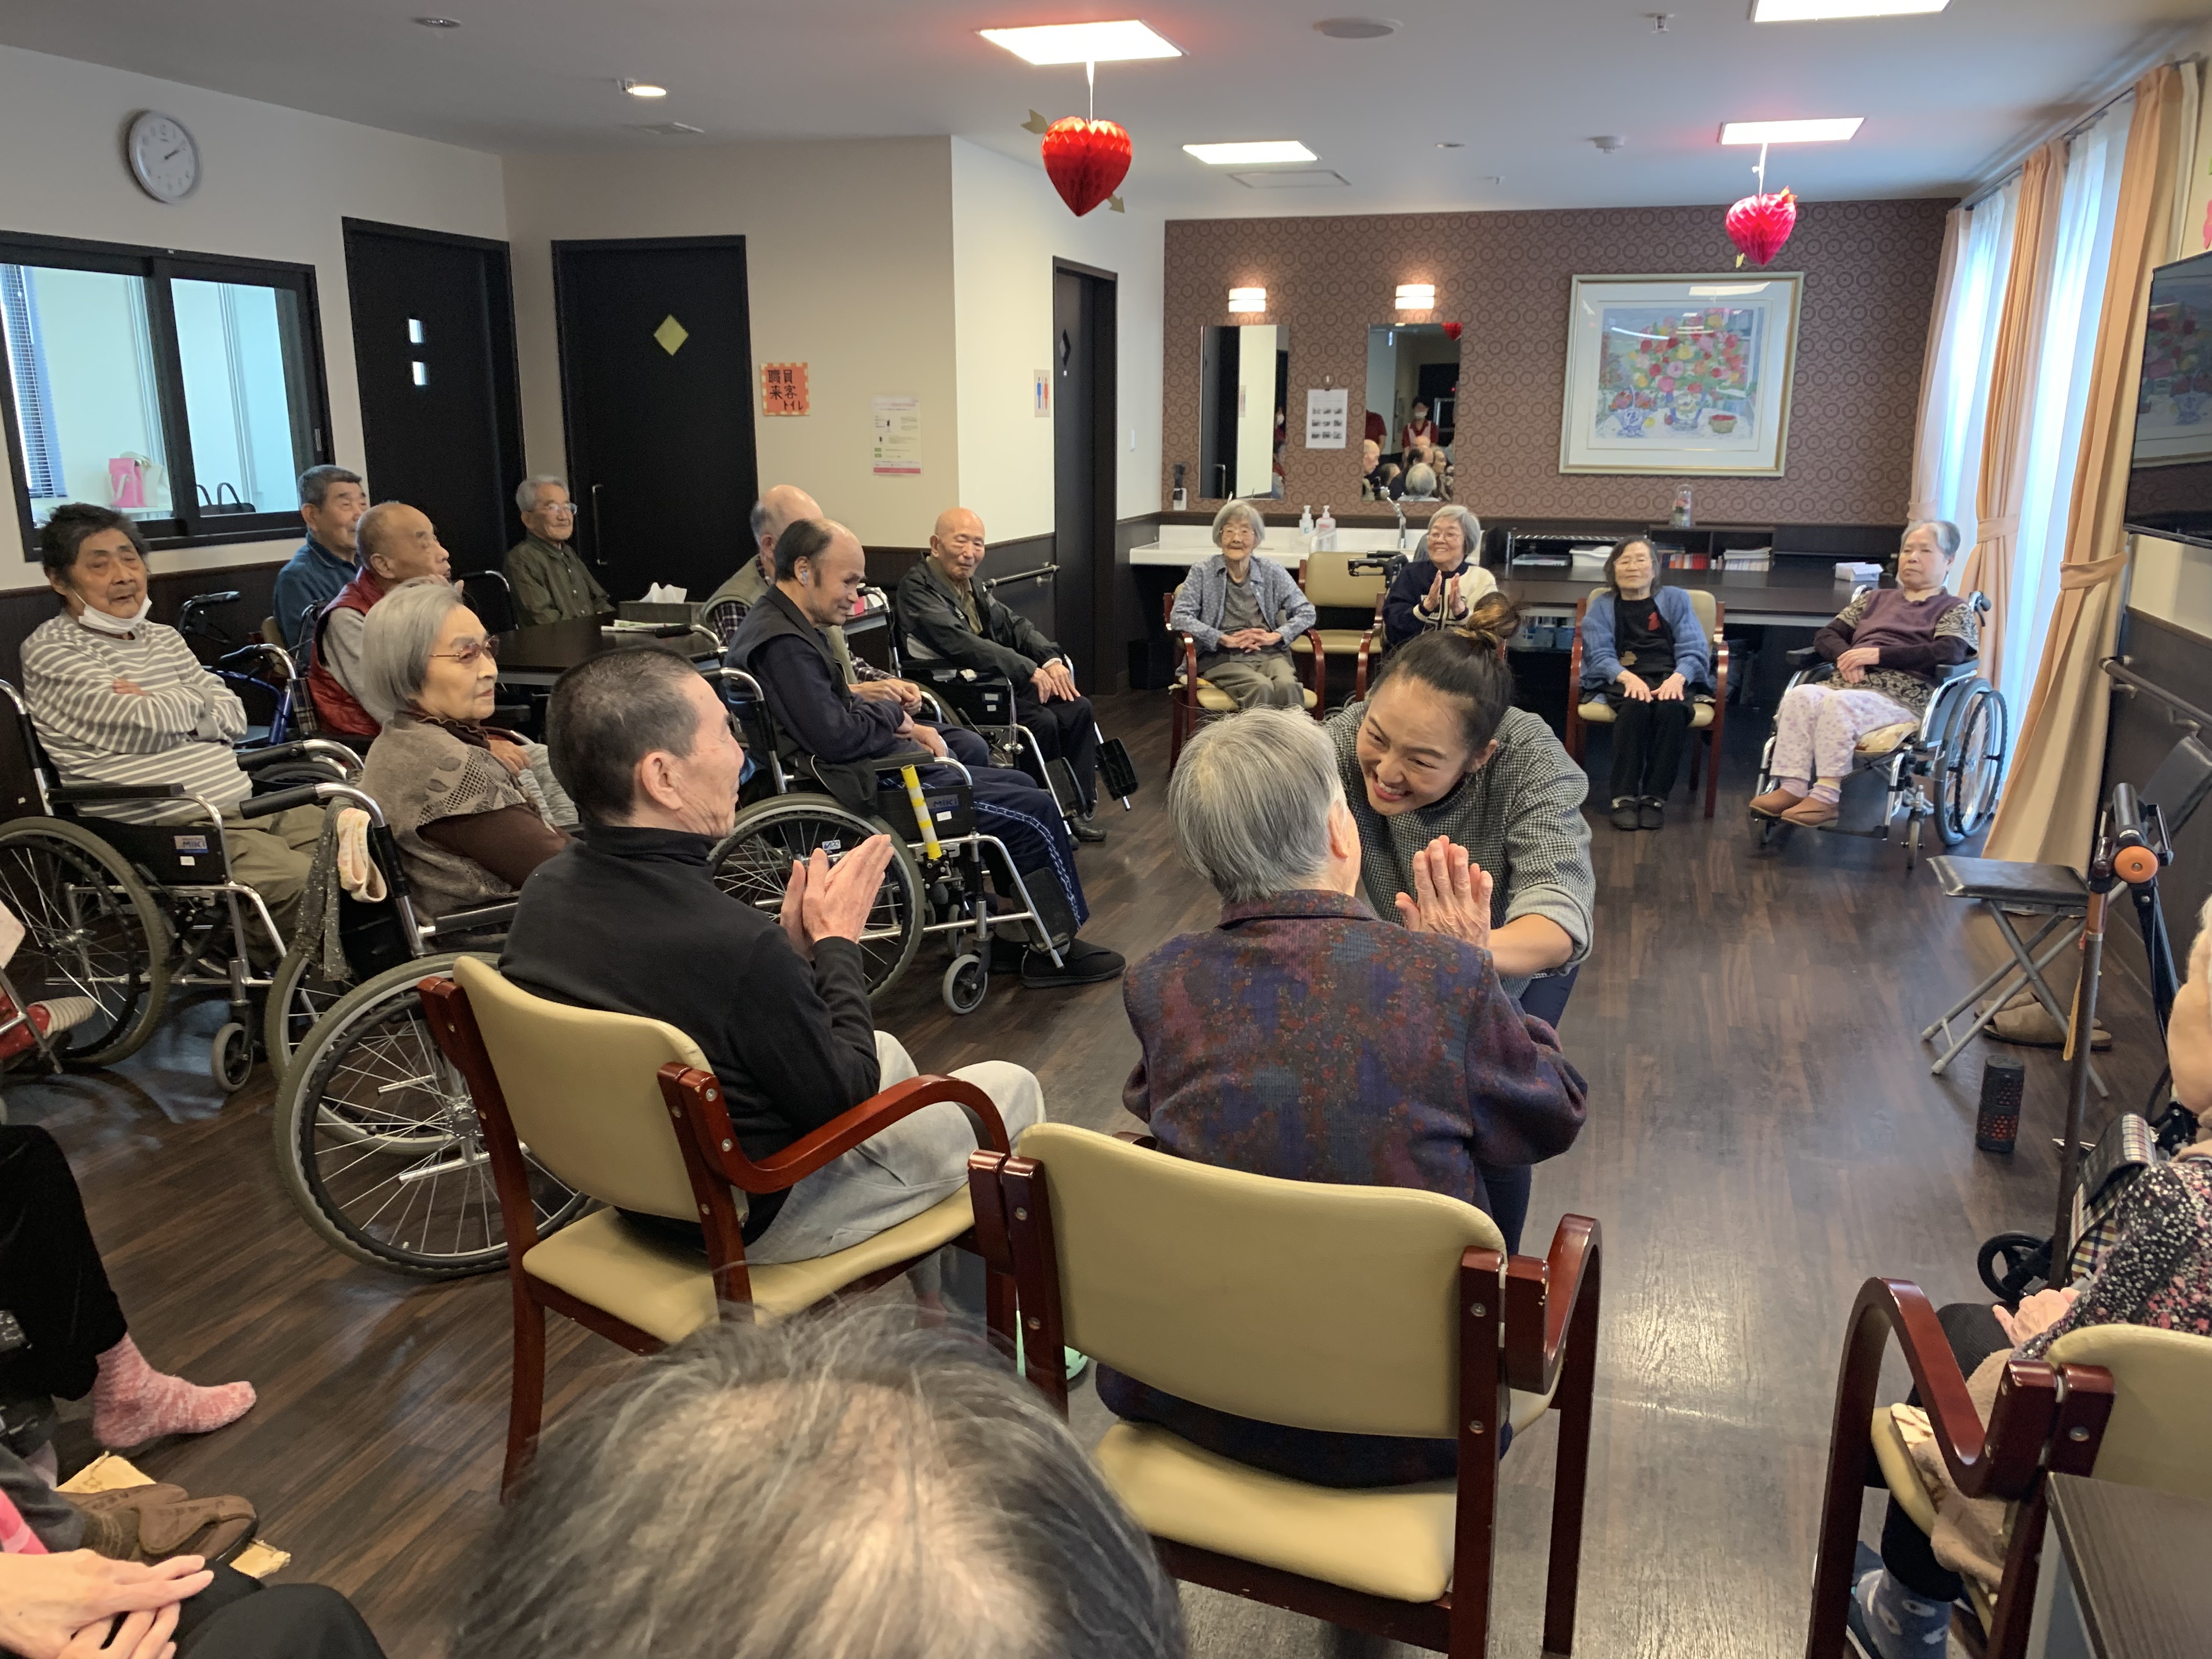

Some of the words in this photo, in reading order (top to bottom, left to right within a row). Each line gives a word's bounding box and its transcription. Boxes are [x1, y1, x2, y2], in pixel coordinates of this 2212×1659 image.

[767, 369, 793, 384] 職員
[769, 385, 798, 400] 来客
[783, 400, 803, 410] トイレ
